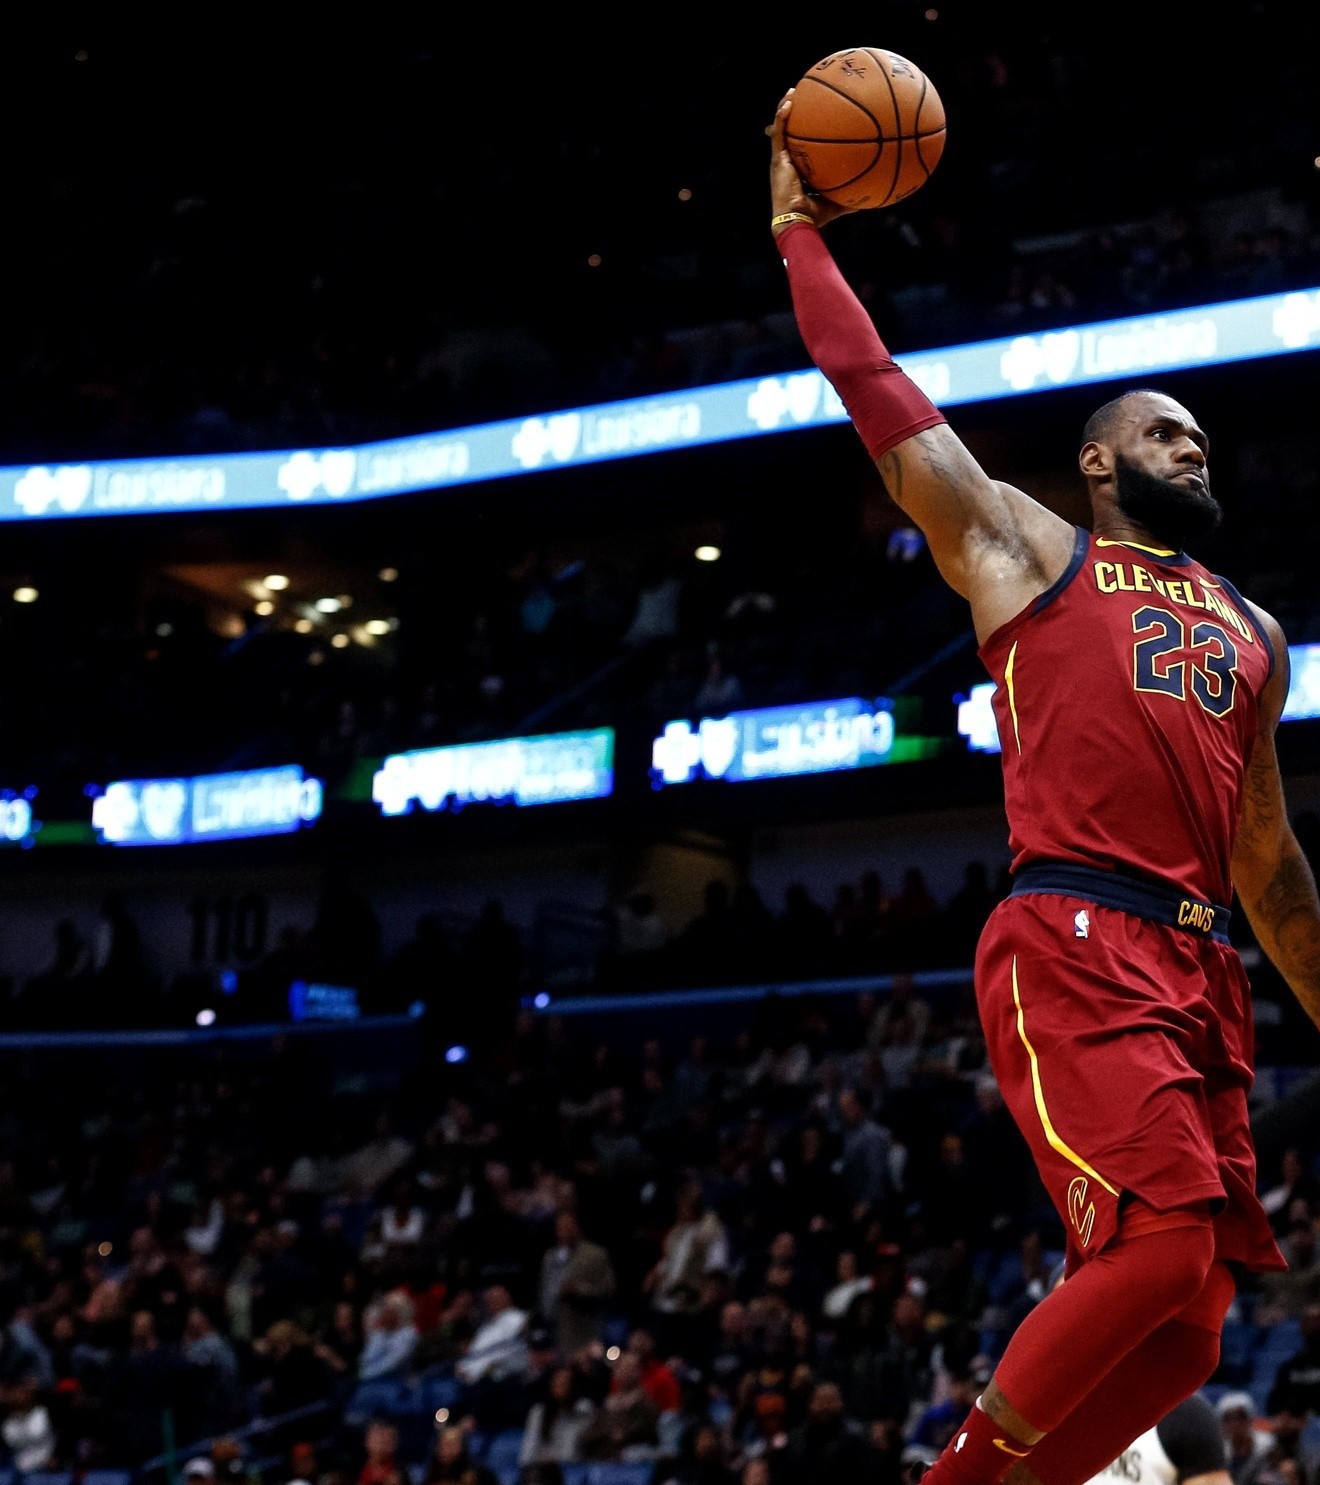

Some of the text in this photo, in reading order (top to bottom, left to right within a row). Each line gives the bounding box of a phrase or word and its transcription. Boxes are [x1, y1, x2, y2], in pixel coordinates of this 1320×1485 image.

[1094, 561, 1253, 643] CLEVELAND
[1132, 605, 1238, 718] 23
[1178, 900, 1215, 932] CAVS
